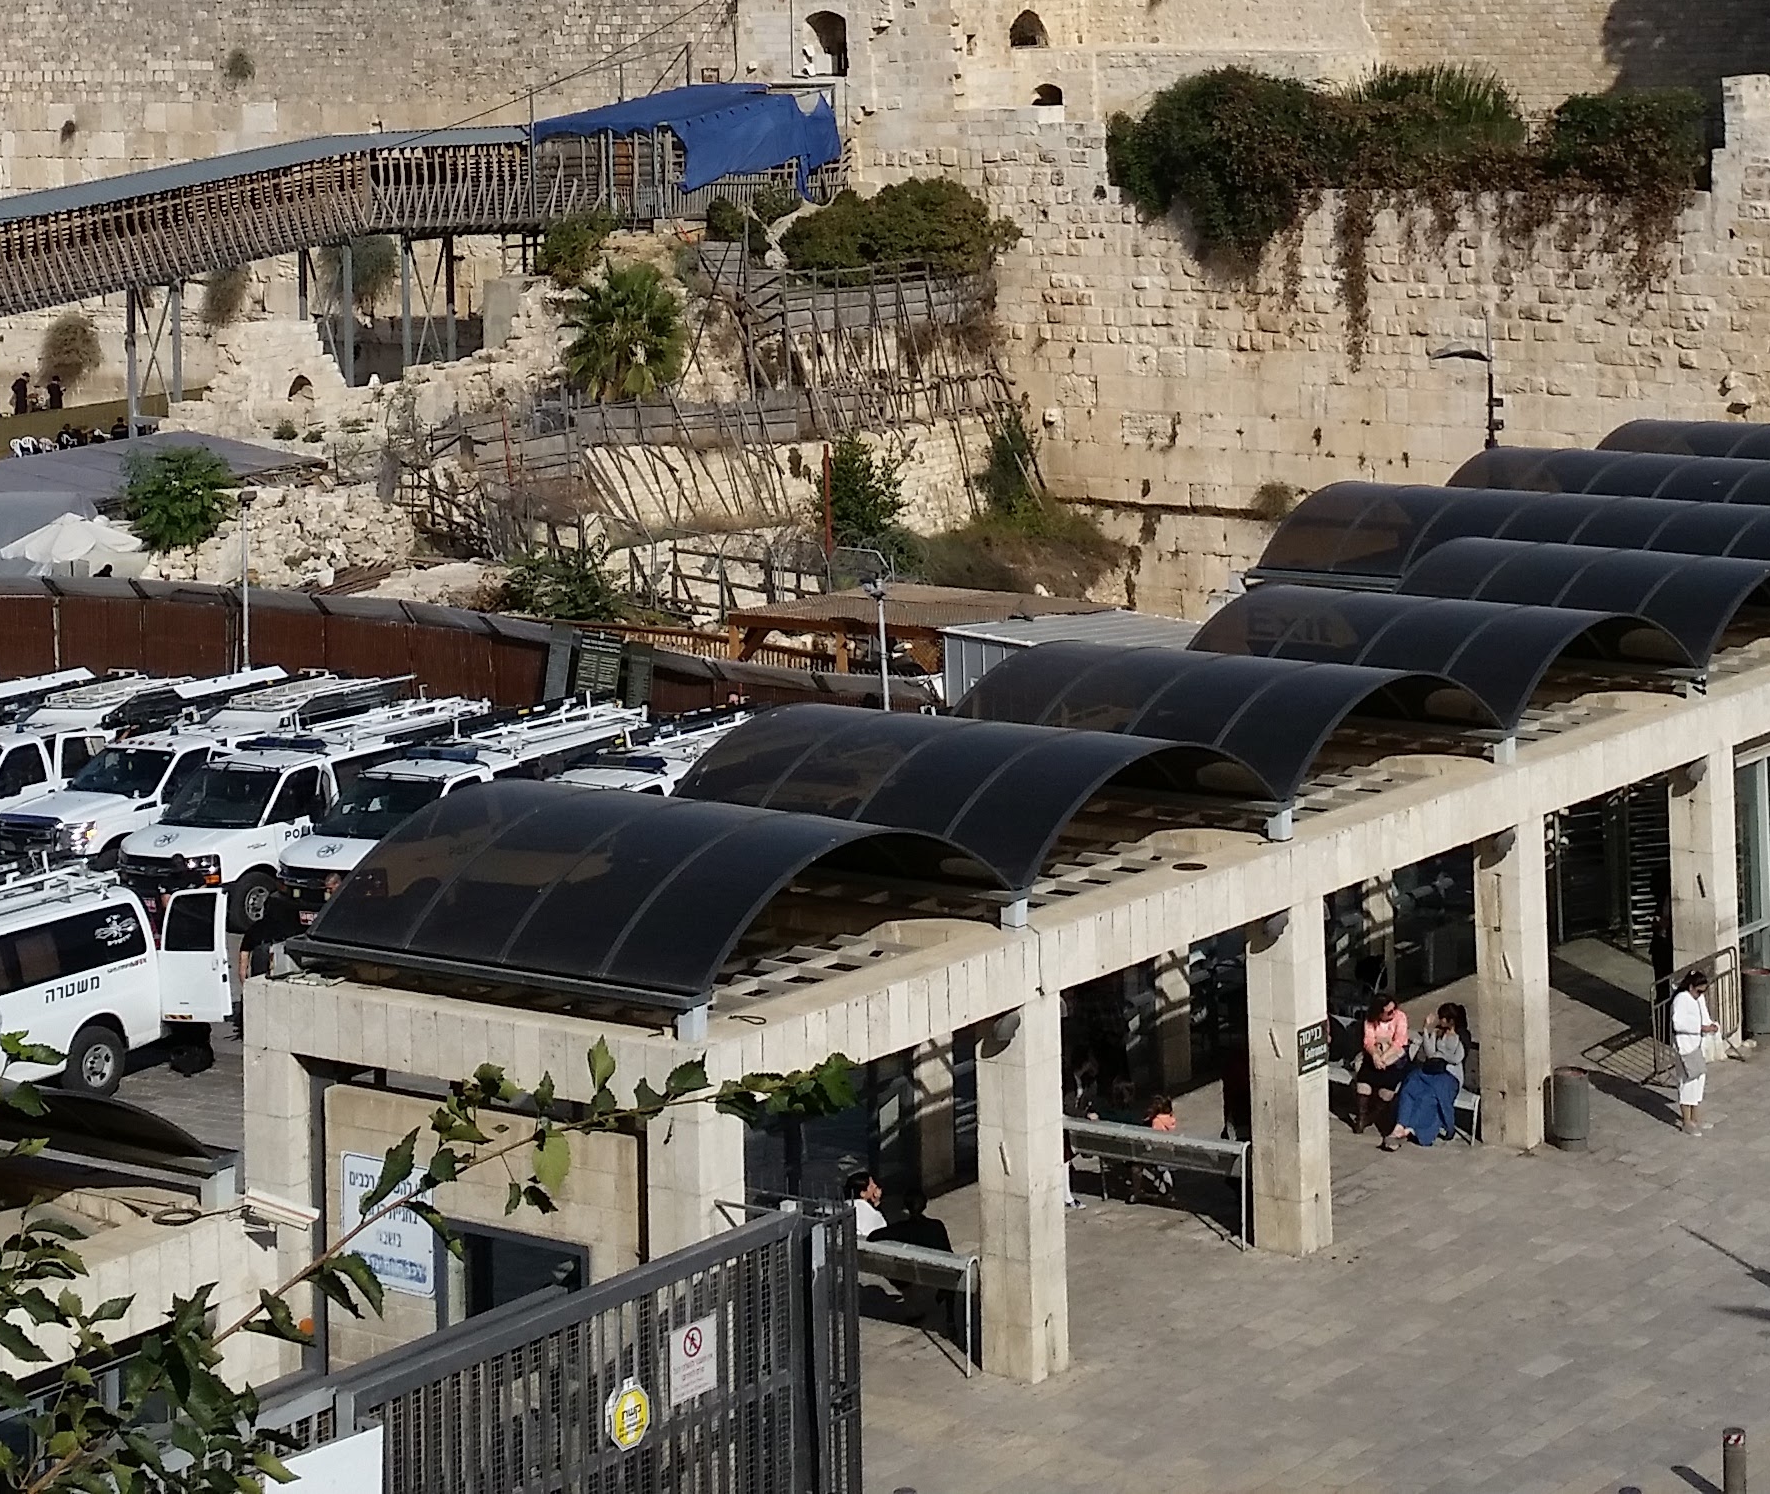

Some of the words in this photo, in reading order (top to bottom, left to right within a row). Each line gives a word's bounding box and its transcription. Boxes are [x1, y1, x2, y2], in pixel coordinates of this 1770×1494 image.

[45, 976, 100, 1003] משטרה
[1300, 1026, 1322, 1046] כניסה
[1304, 1043, 1327, 1061] Entrance
[349, 1171, 375, 1189] רכבים
[622, 1404, 641, 1420] קשת
